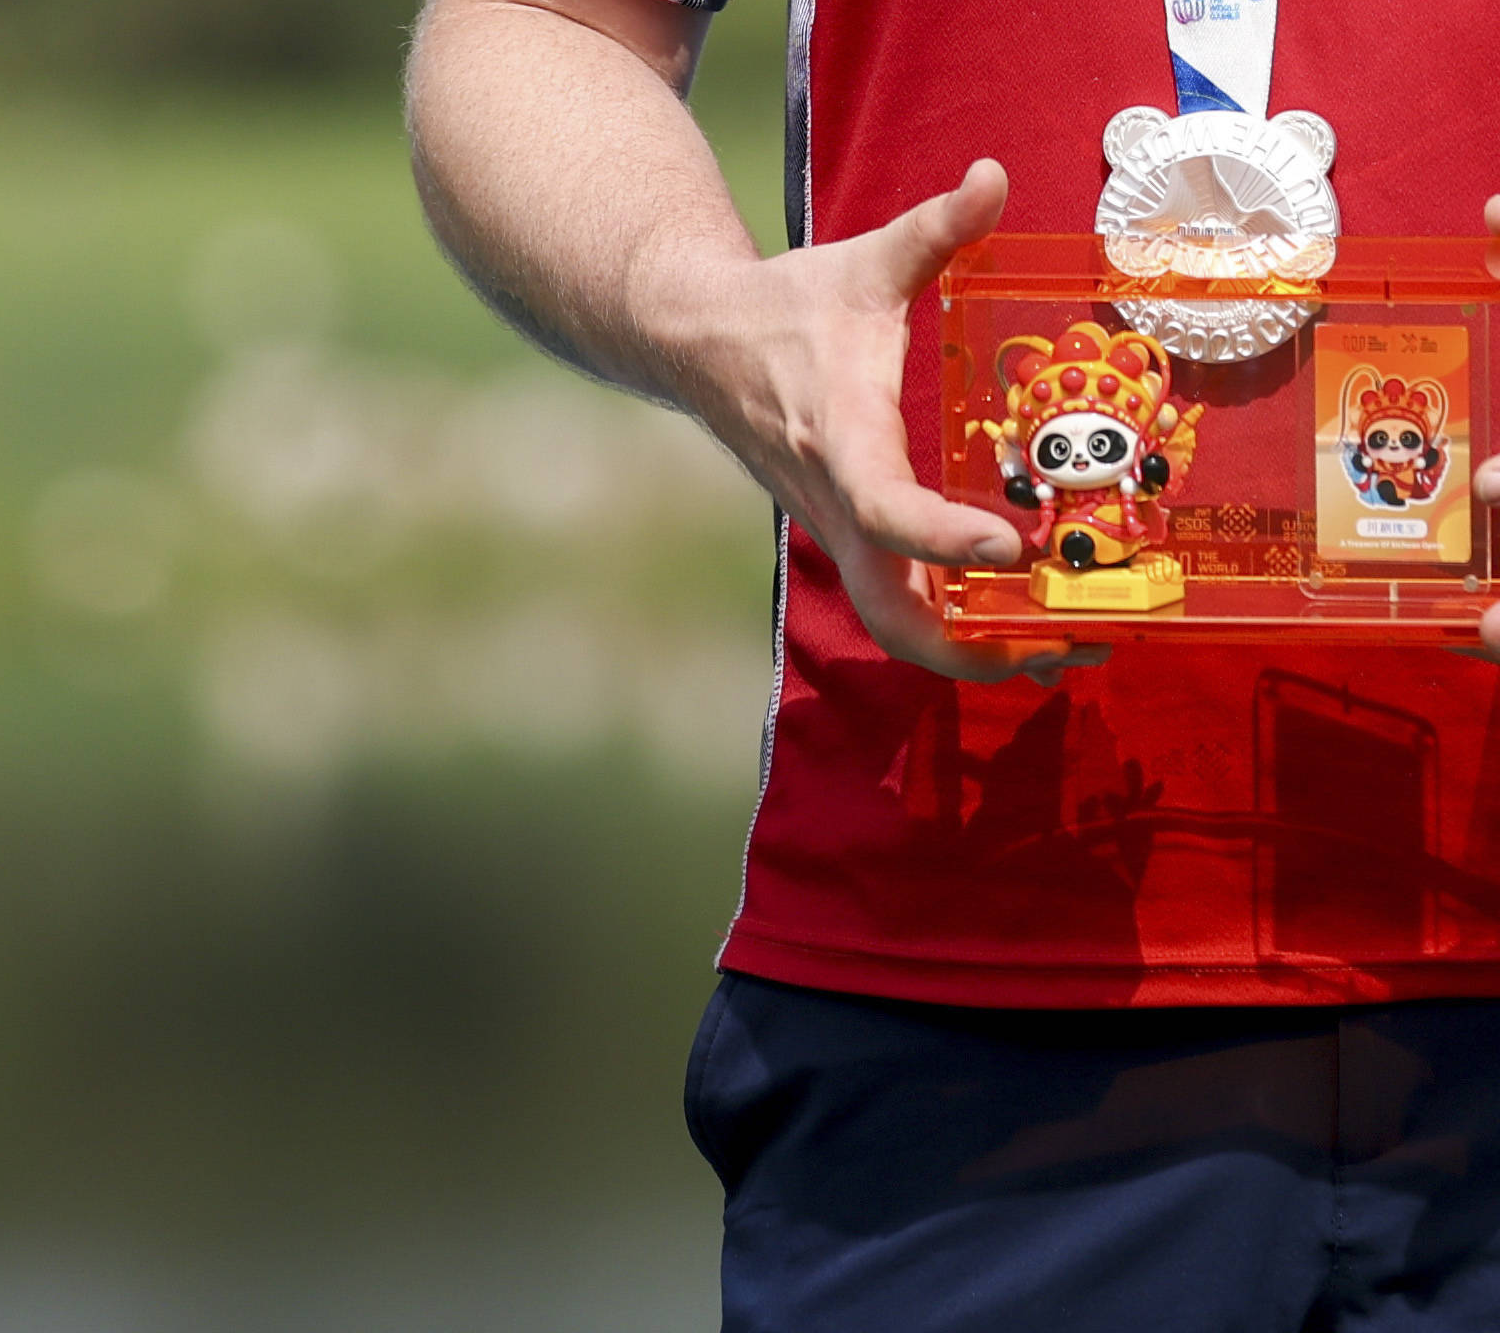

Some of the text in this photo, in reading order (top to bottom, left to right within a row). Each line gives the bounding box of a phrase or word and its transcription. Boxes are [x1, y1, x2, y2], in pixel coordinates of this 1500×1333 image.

[1161, 320, 1256, 361] 2025
[1197, 552, 1219, 562] THE
[1197, 563, 1239, 574] WORLD
